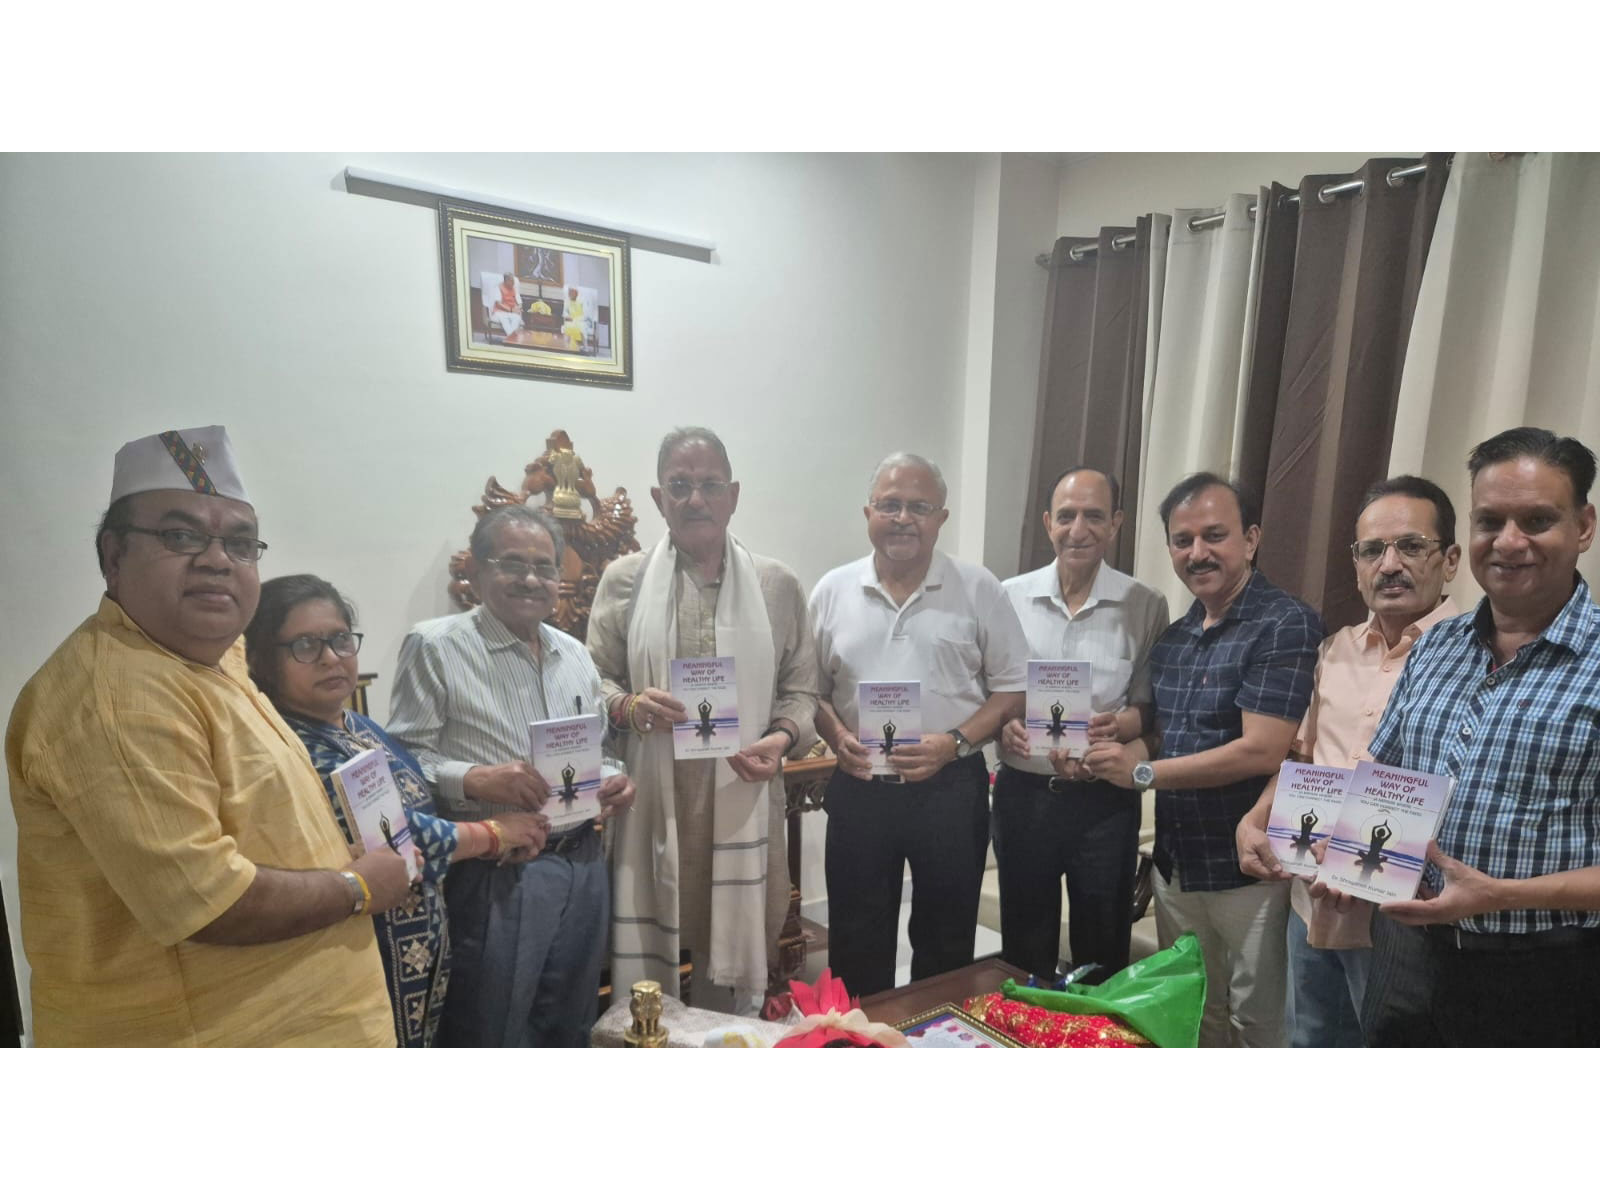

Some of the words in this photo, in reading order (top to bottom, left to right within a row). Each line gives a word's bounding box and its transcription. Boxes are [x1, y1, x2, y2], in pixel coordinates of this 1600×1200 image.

[683, 661, 723, 669] MEANINGFUL
[546, 723, 587, 734] MEANINGFUL
[546, 740, 574, 749] HEALTHY
[576, 737, 588, 745] LIFE
[1295, 767, 1345, 780] MEANINGFUL
[1303, 776, 1321, 784] WAY
[1372, 769, 1429, 788] MEANINGFUL
[1291, 782, 1325, 793] HEALTHY
[1326, 788, 1343, 796] LIFE
[1380, 780, 1401, 792] WAY
[1402, 785, 1416, 794] OF
[1365, 786, 1405, 802] HEALTHY
[1406, 794, 1425, 807] LIFE
